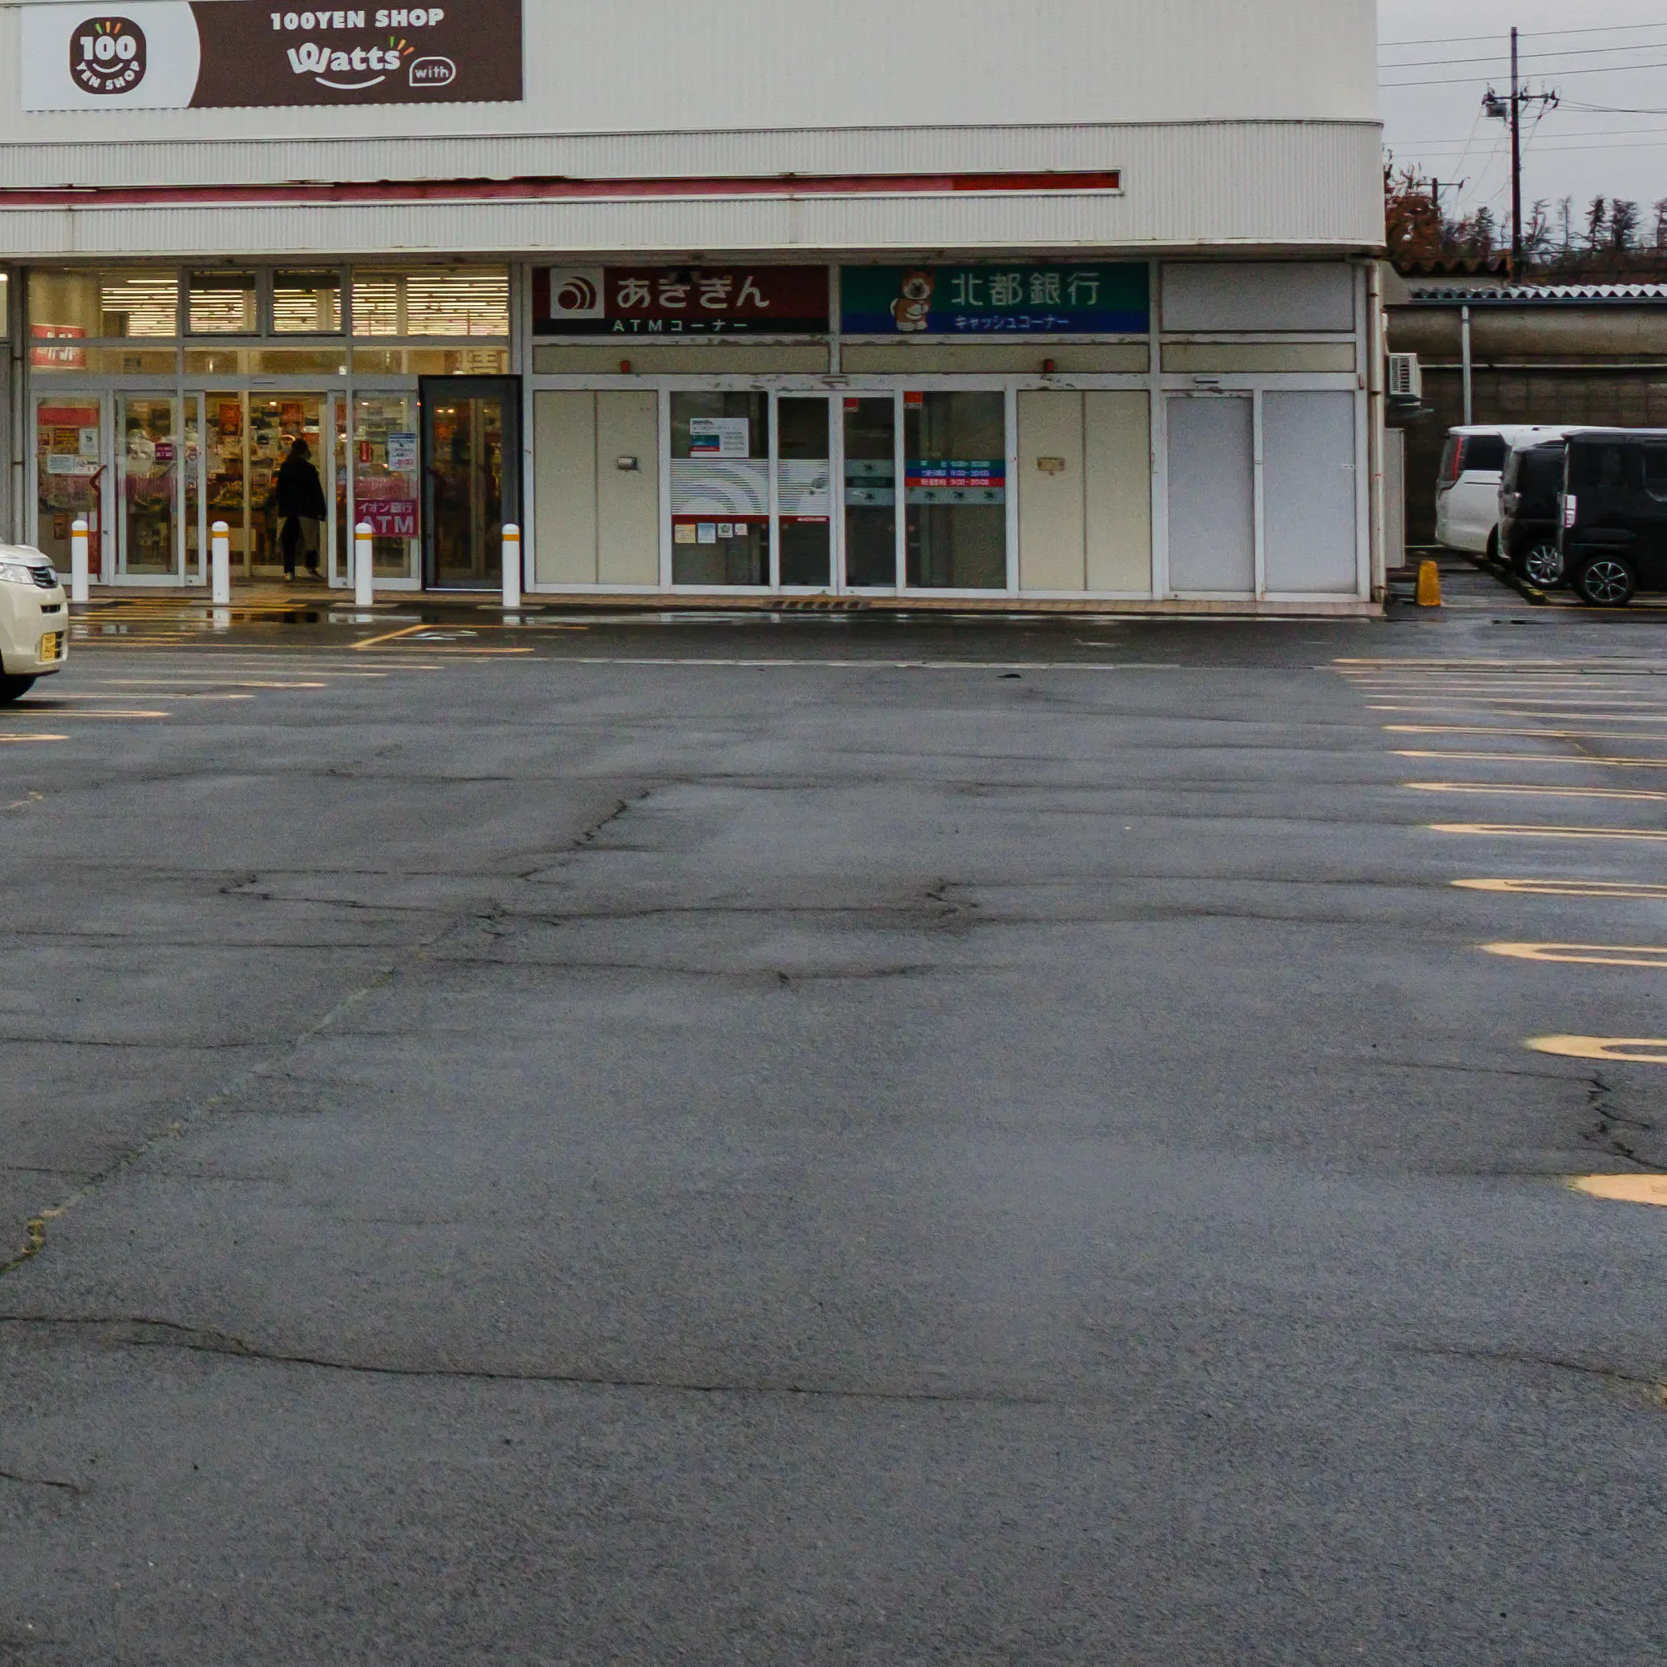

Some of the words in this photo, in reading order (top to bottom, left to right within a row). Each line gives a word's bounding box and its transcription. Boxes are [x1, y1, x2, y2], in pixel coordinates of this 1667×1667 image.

[270, 10, 366, 31] 100YEN
[374, 8, 445, 28] SHOP
[79, 35, 137, 61] 100
[286, 42, 402, 74] Watts
[75, 60, 101, 89] YEN
[104, 60, 140, 91] SHOP
[414, 65, 450, 80] with
[951, 272, 1100, 306] 北都銀行
[955, 315, 1069, 330] キャッシュコーナー
[362, 516, 414, 534] ATM
